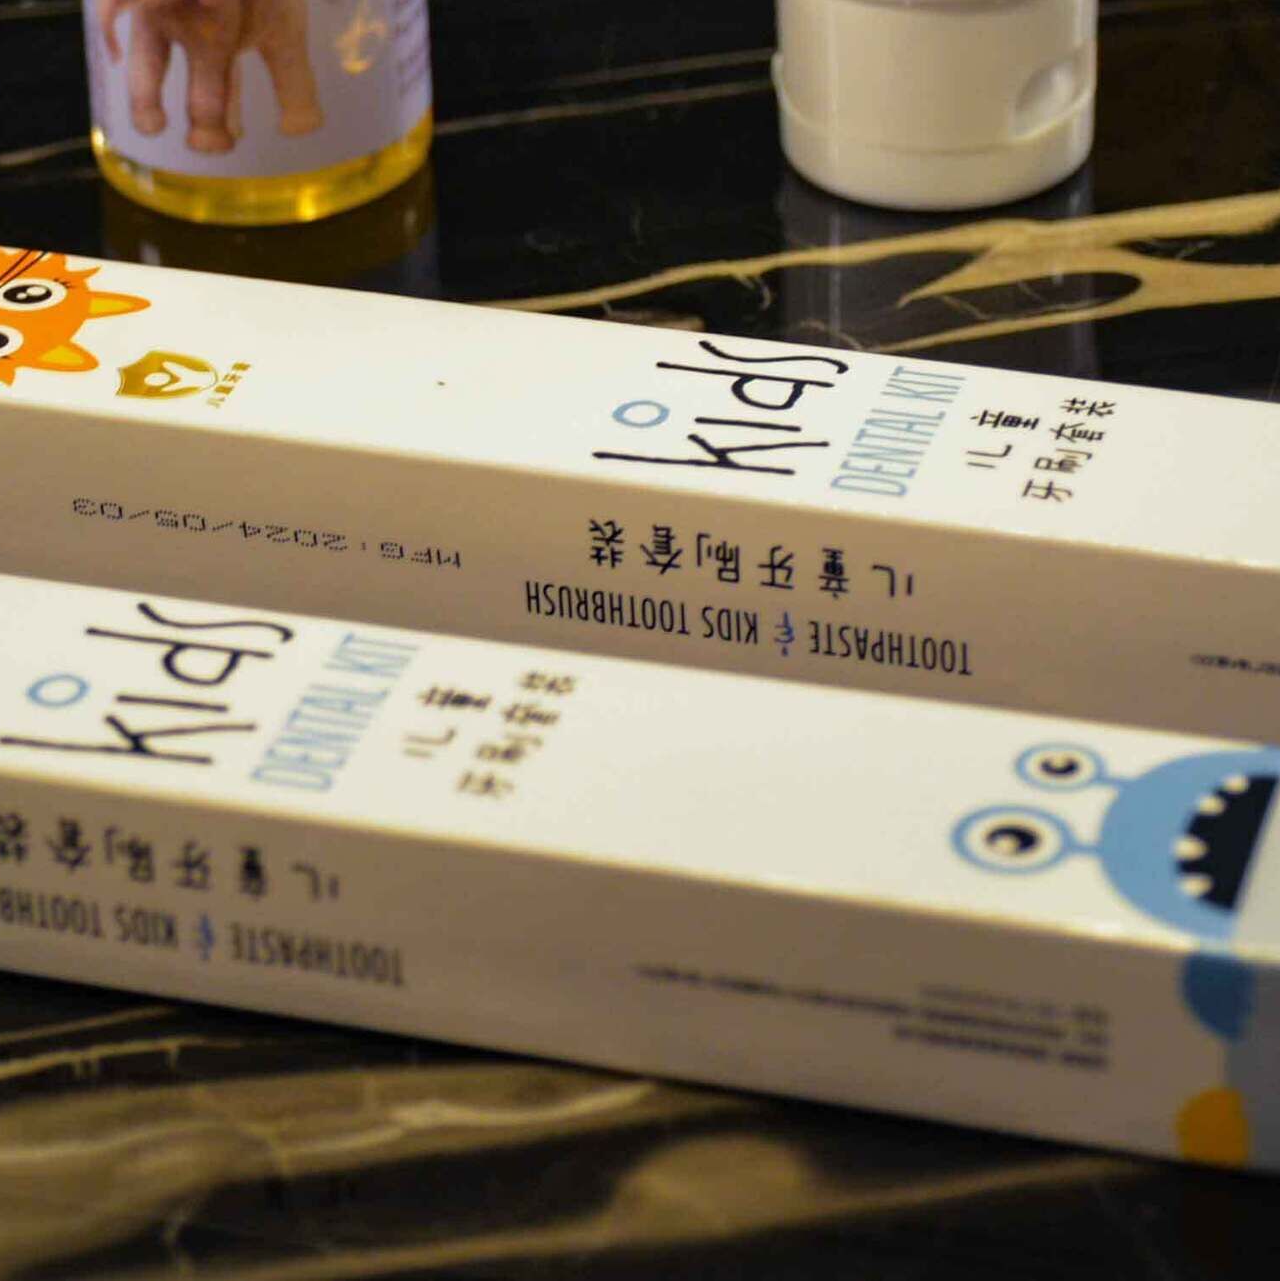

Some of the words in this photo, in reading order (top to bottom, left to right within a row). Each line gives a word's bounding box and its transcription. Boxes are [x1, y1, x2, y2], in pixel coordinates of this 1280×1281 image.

[882, 365, 967, 404] KIT
[830, 408, 946, 497] DENTAL
[965, 409, 1040, 469] 儿童
[1021, 396, 1117, 503] 牙刷套装
[588, 518, 916, 601] 儿童牙刷套装
[526, 581, 691, 637] TOOTHBRUSH
[700, 605, 760, 645] KIDS
[808, 621, 972, 676] TOOTHPASTE
[249, 684, 391, 793] DENTAL
[324, 632, 420, 678] KIT
[112, 904, 180, 952] KIDS
[229, 922, 405, 987] TOOTHPASTE
